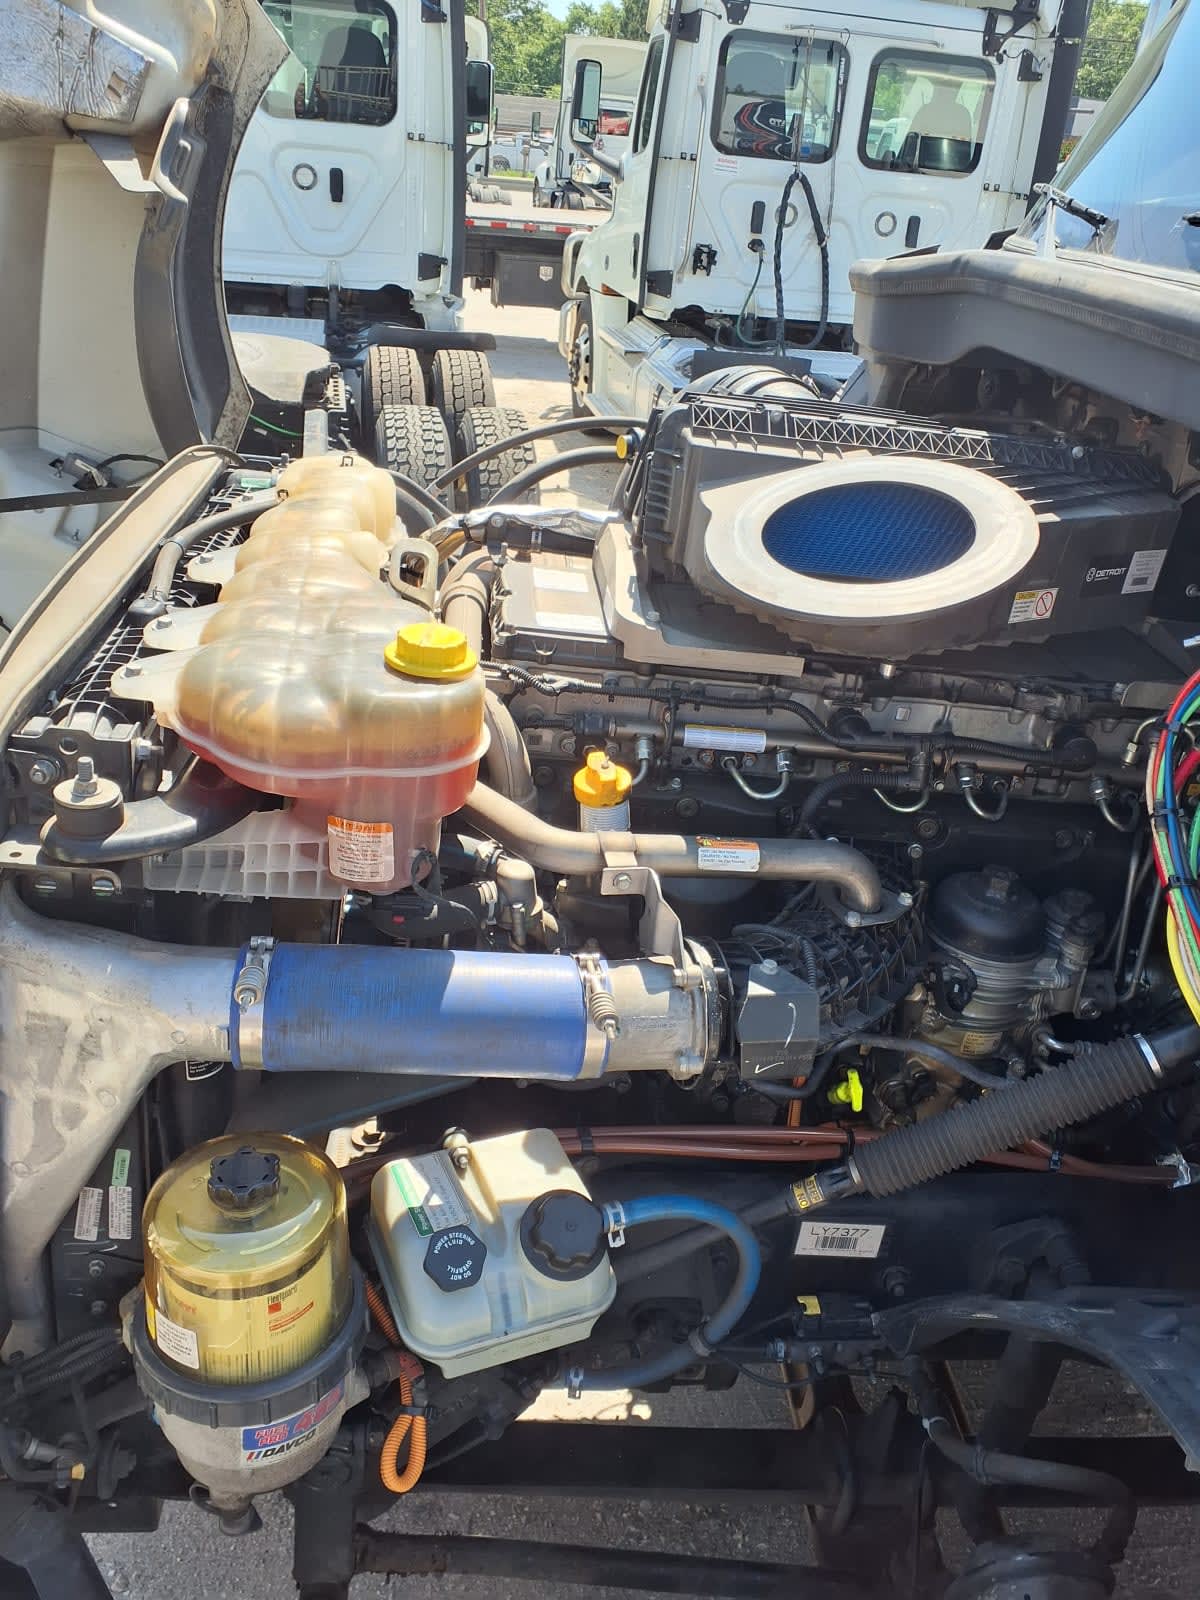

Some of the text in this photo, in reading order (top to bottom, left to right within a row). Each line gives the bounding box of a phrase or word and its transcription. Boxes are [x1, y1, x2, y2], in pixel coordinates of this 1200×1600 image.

[1095, 567, 1127, 578] DETROIT
[811, 1226, 870, 1237] LY7377
[433, 1232, 476, 1254] POWER STEERING
[444, 1239, 463, 1248] FLUID
[447, 1260, 472, 1274] OVERFILL
[463, 1270, 472, 1278] DO
[262, 1428, 317, 1458] DAVCO
